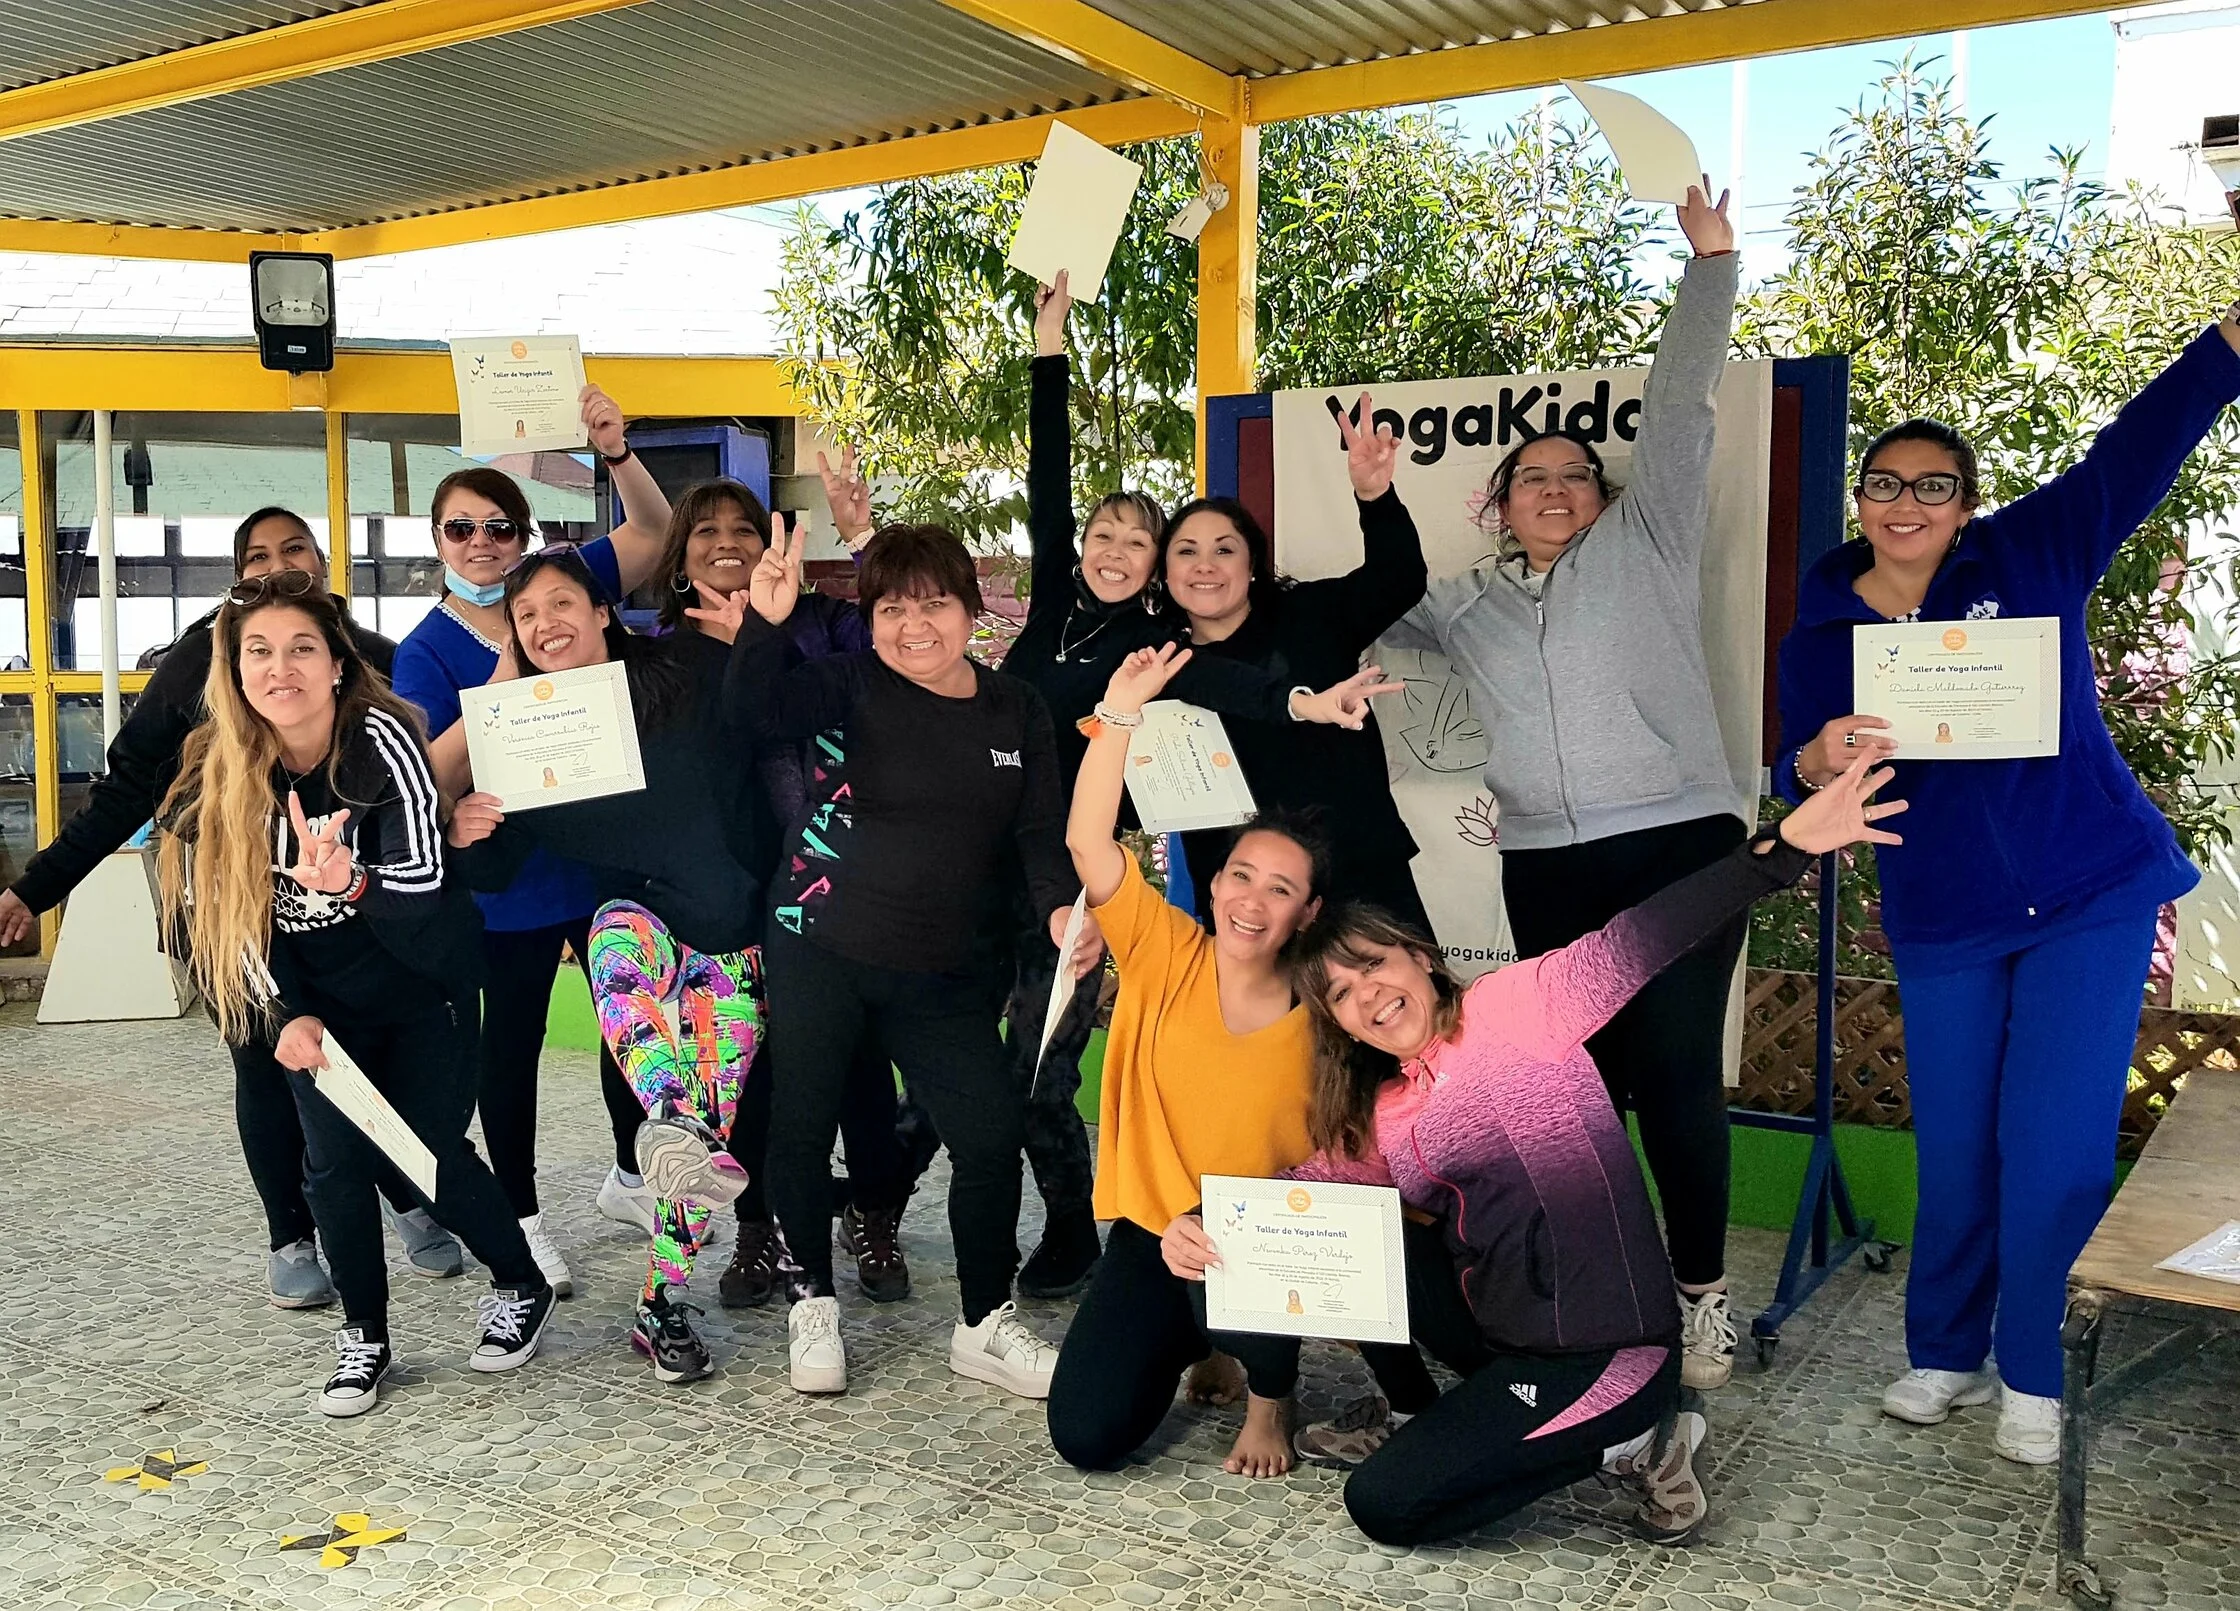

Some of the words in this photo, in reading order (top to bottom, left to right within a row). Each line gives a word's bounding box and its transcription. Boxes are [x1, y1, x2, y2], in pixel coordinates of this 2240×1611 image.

[1908, 665, 1934, 673] Taller
[1935, 665, 1946, 673] de
[1948, 665, 1969, 675] Yoga
[1971, 664, 2003, 673] Infantil
[510, 717, 531, 726] Taller
[532, 714, 541, 722] de
[542, 712, 560, 722] Yoga
[560, 707, 587, 717] Infantil
[1255, 1225, 1280, 1235] Taller
[1281, 1227, 1292, 1236] de
[1293, 1228, 1315, 1238] Yoga
[1316, 1229, 1348, 1239] Infantil
